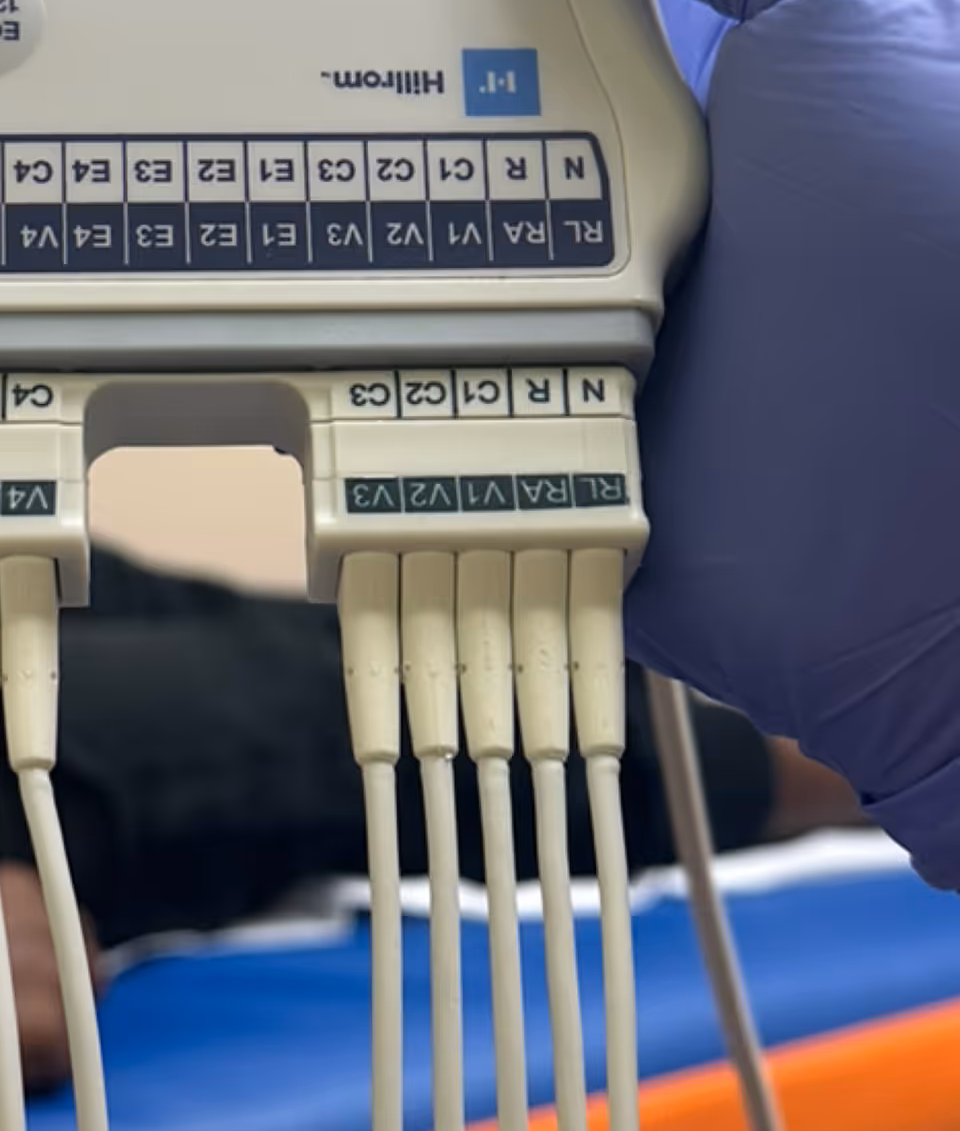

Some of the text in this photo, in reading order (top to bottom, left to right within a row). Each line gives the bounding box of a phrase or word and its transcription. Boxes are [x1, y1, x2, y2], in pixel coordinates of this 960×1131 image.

[13, 160, 53, 184] C4
[71, 159, 110, 183] E4
[135, 159, 172, 183] E3
[197, 159, 236, 183] E2
[260, 159, 294, 182] E1
[318, 158, 356, 182] C3
[377, 158, 415, 182] C2
[439, 158, 474, 182] C1
[506, 157, 527, 180] R
[564, 156, 585, 179] N
[20, 225, 58, 248] V4
[73, 225, 112, 247] E4
[135, 224, 173, 247] E3
[199, 224, 237, 246] E2
[263, 223, 296, 246] E1
[326, 223, 364, 246] V3
[386, 222, 424, 245] V2
[448, 221, 482, 244] V1
[503, 221, 546, 244] RA
[563, 220, 603, 243] RL
[12, 384, 54, 407] C4
[349, 379, 606, 406] N R C1 C2 C3
[7, 486, 49, 509] V4
[352, 477, 622, 507] RL RA V1 V2 V3
